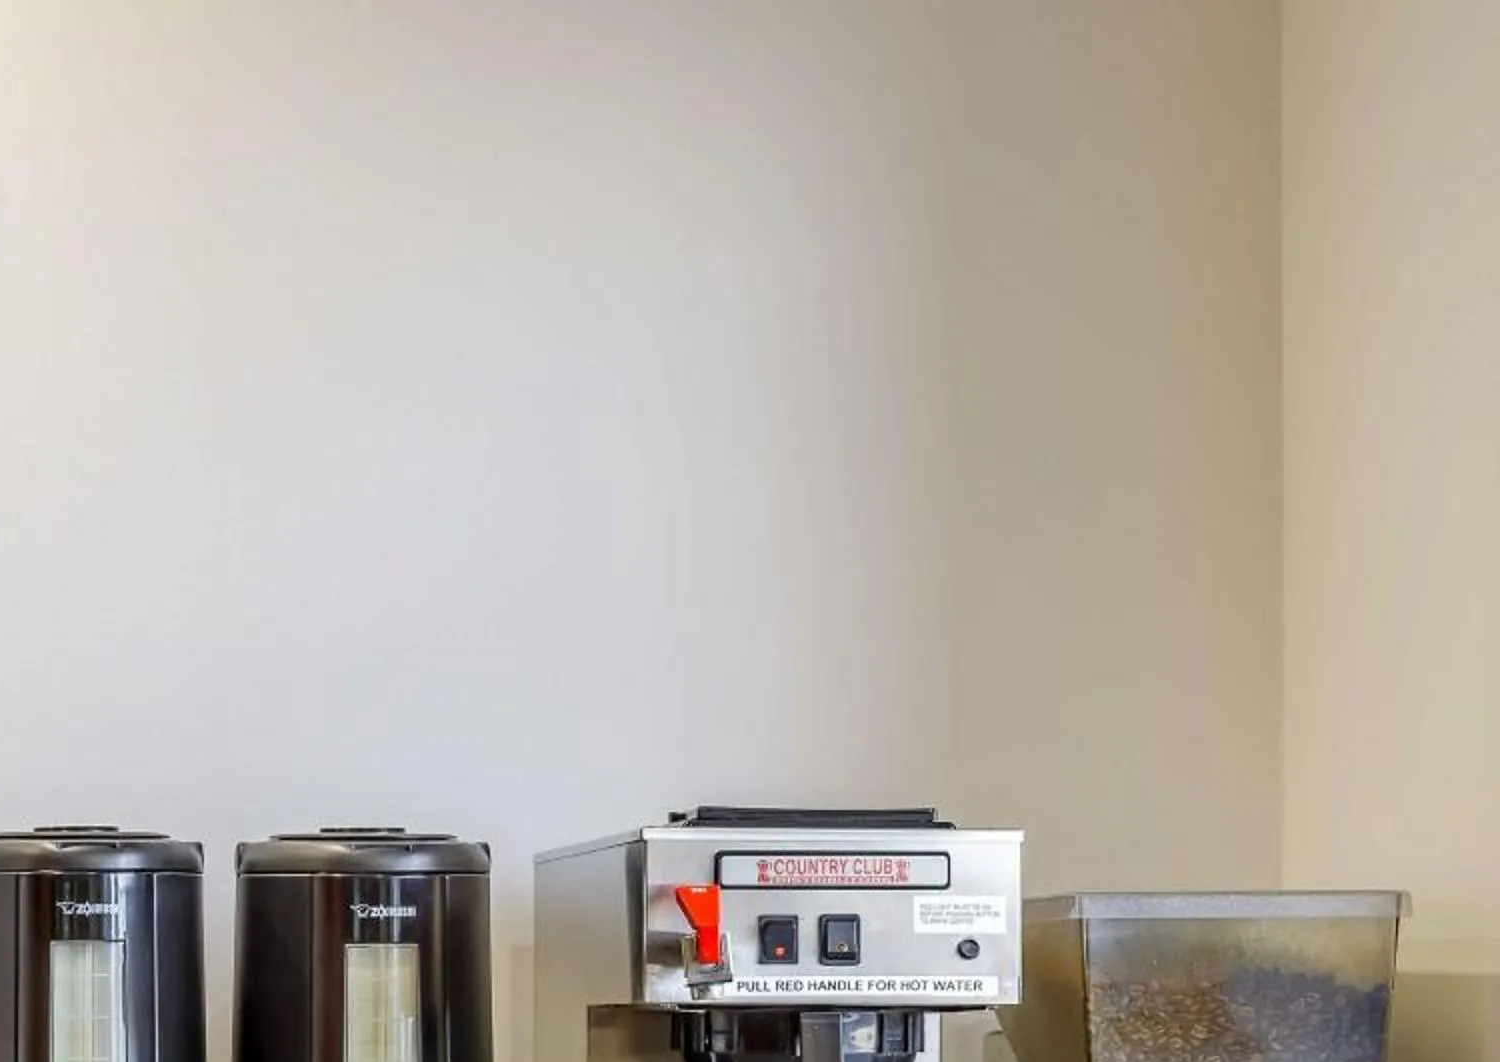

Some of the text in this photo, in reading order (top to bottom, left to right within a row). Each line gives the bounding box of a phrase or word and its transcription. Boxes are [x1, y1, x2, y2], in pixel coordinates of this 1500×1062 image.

[773, 858, 893, 876] COUNTRY CLUB
[736, 979, 983, 993] PULL RED HANDLE FOR HOT WATER
